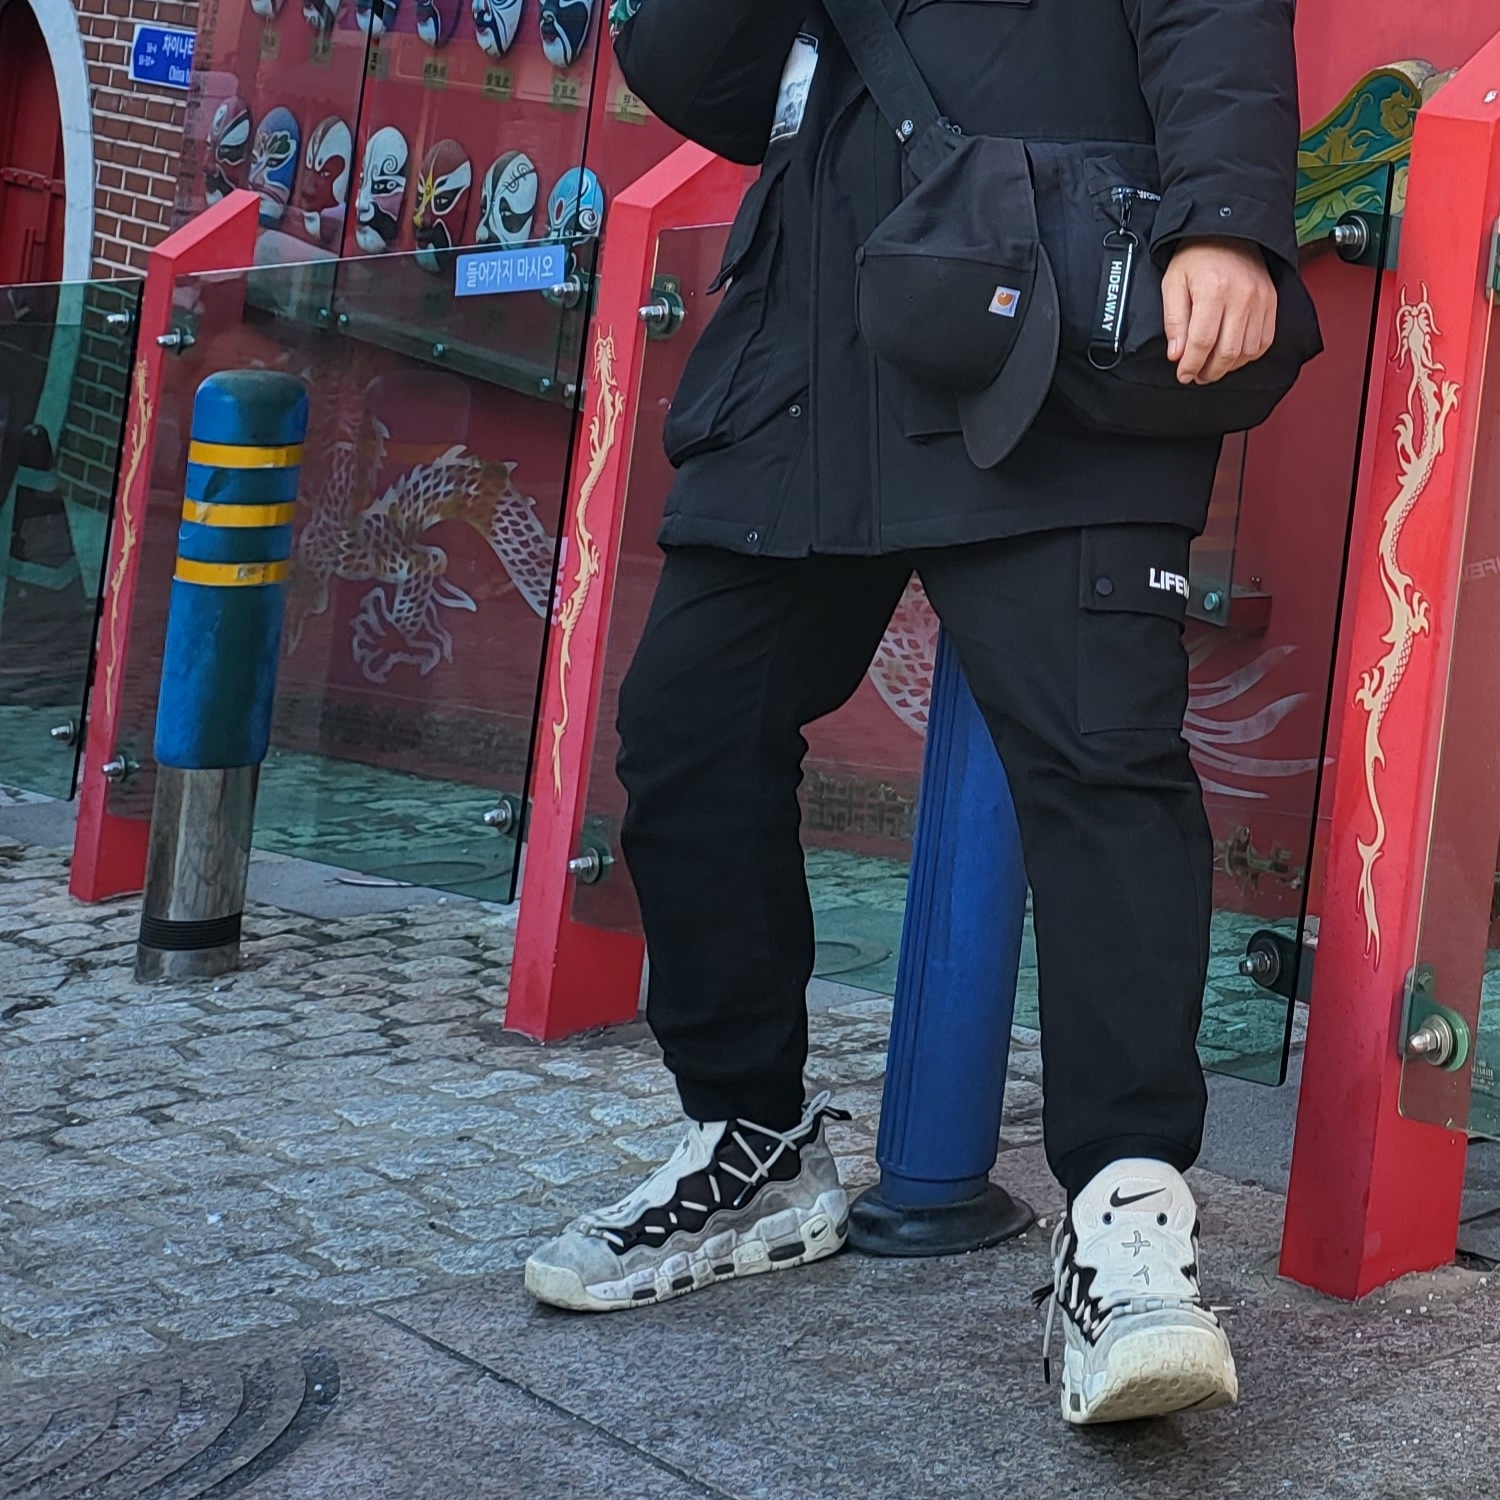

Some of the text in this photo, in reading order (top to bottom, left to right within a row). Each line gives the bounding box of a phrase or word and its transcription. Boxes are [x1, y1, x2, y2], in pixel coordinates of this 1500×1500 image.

[466, 254, 554, 288] 들어가지 마시오
[1101, 260, 1123, 332] HIDEAWAY
